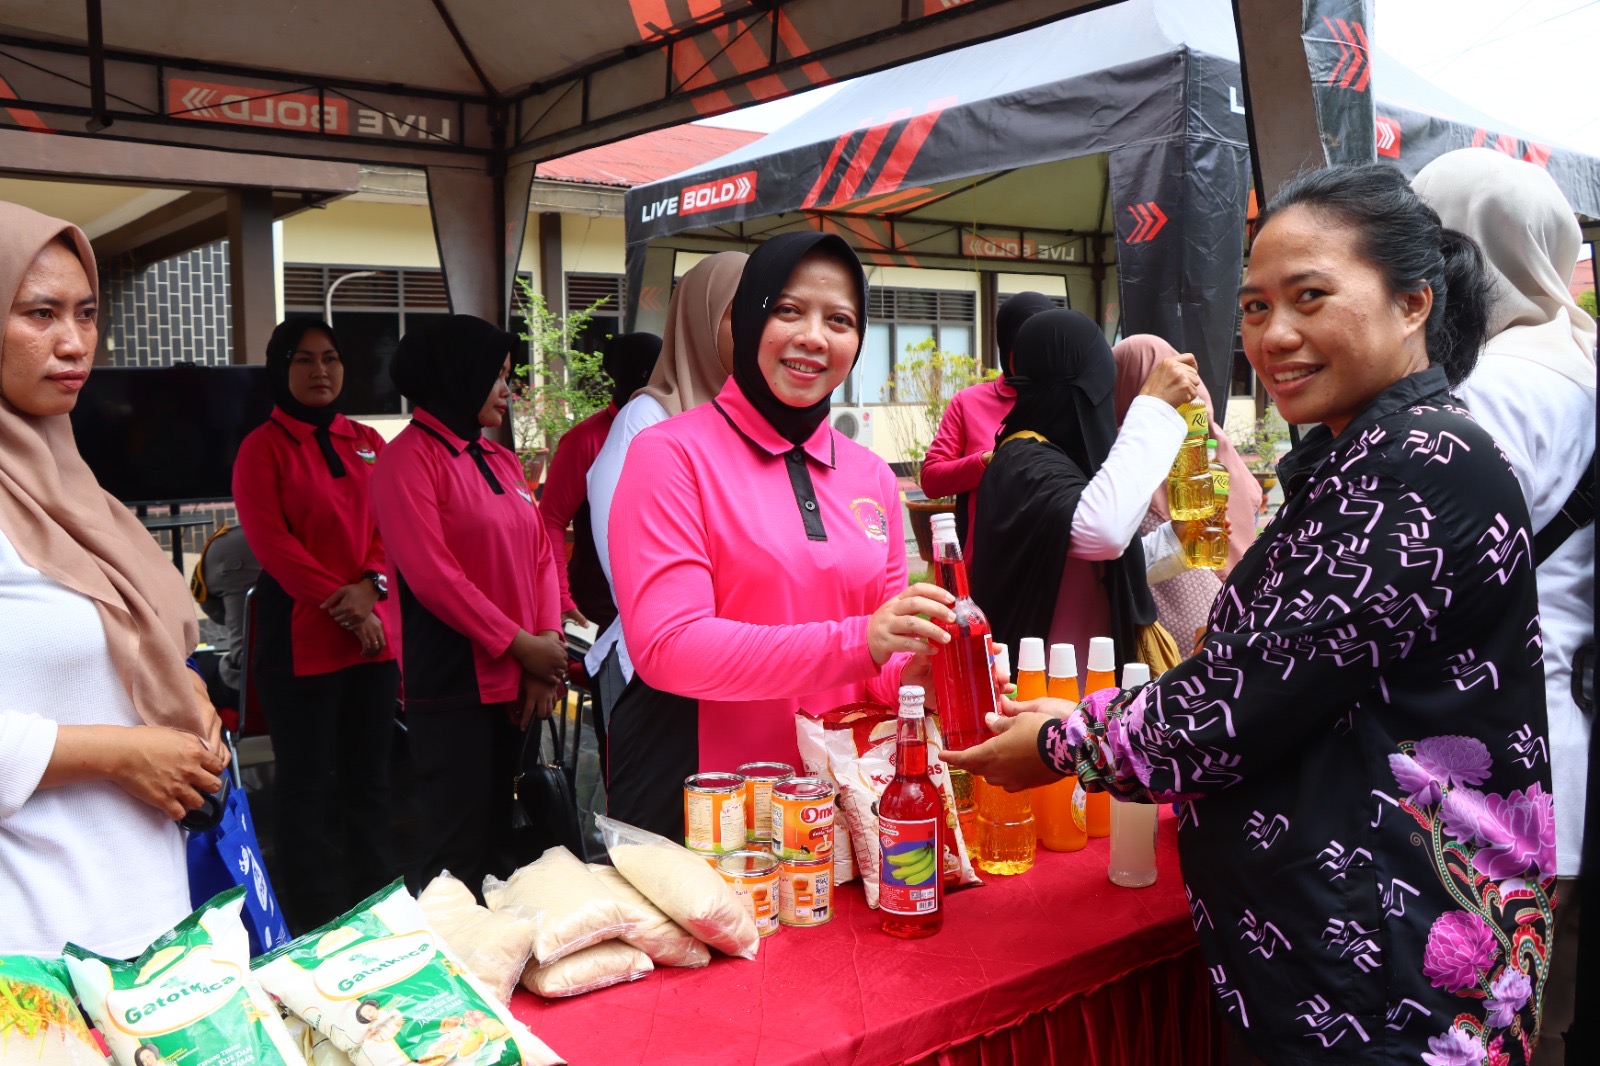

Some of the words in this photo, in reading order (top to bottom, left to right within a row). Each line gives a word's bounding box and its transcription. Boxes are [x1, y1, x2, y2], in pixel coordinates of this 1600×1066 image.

[641, 196, 679, 223] LIVE
[682, 182, 736, 210] BOLD
[338, 942, 430, 992] Gatotkaca
[125, 974, 236, 1025] Gatotkaca
